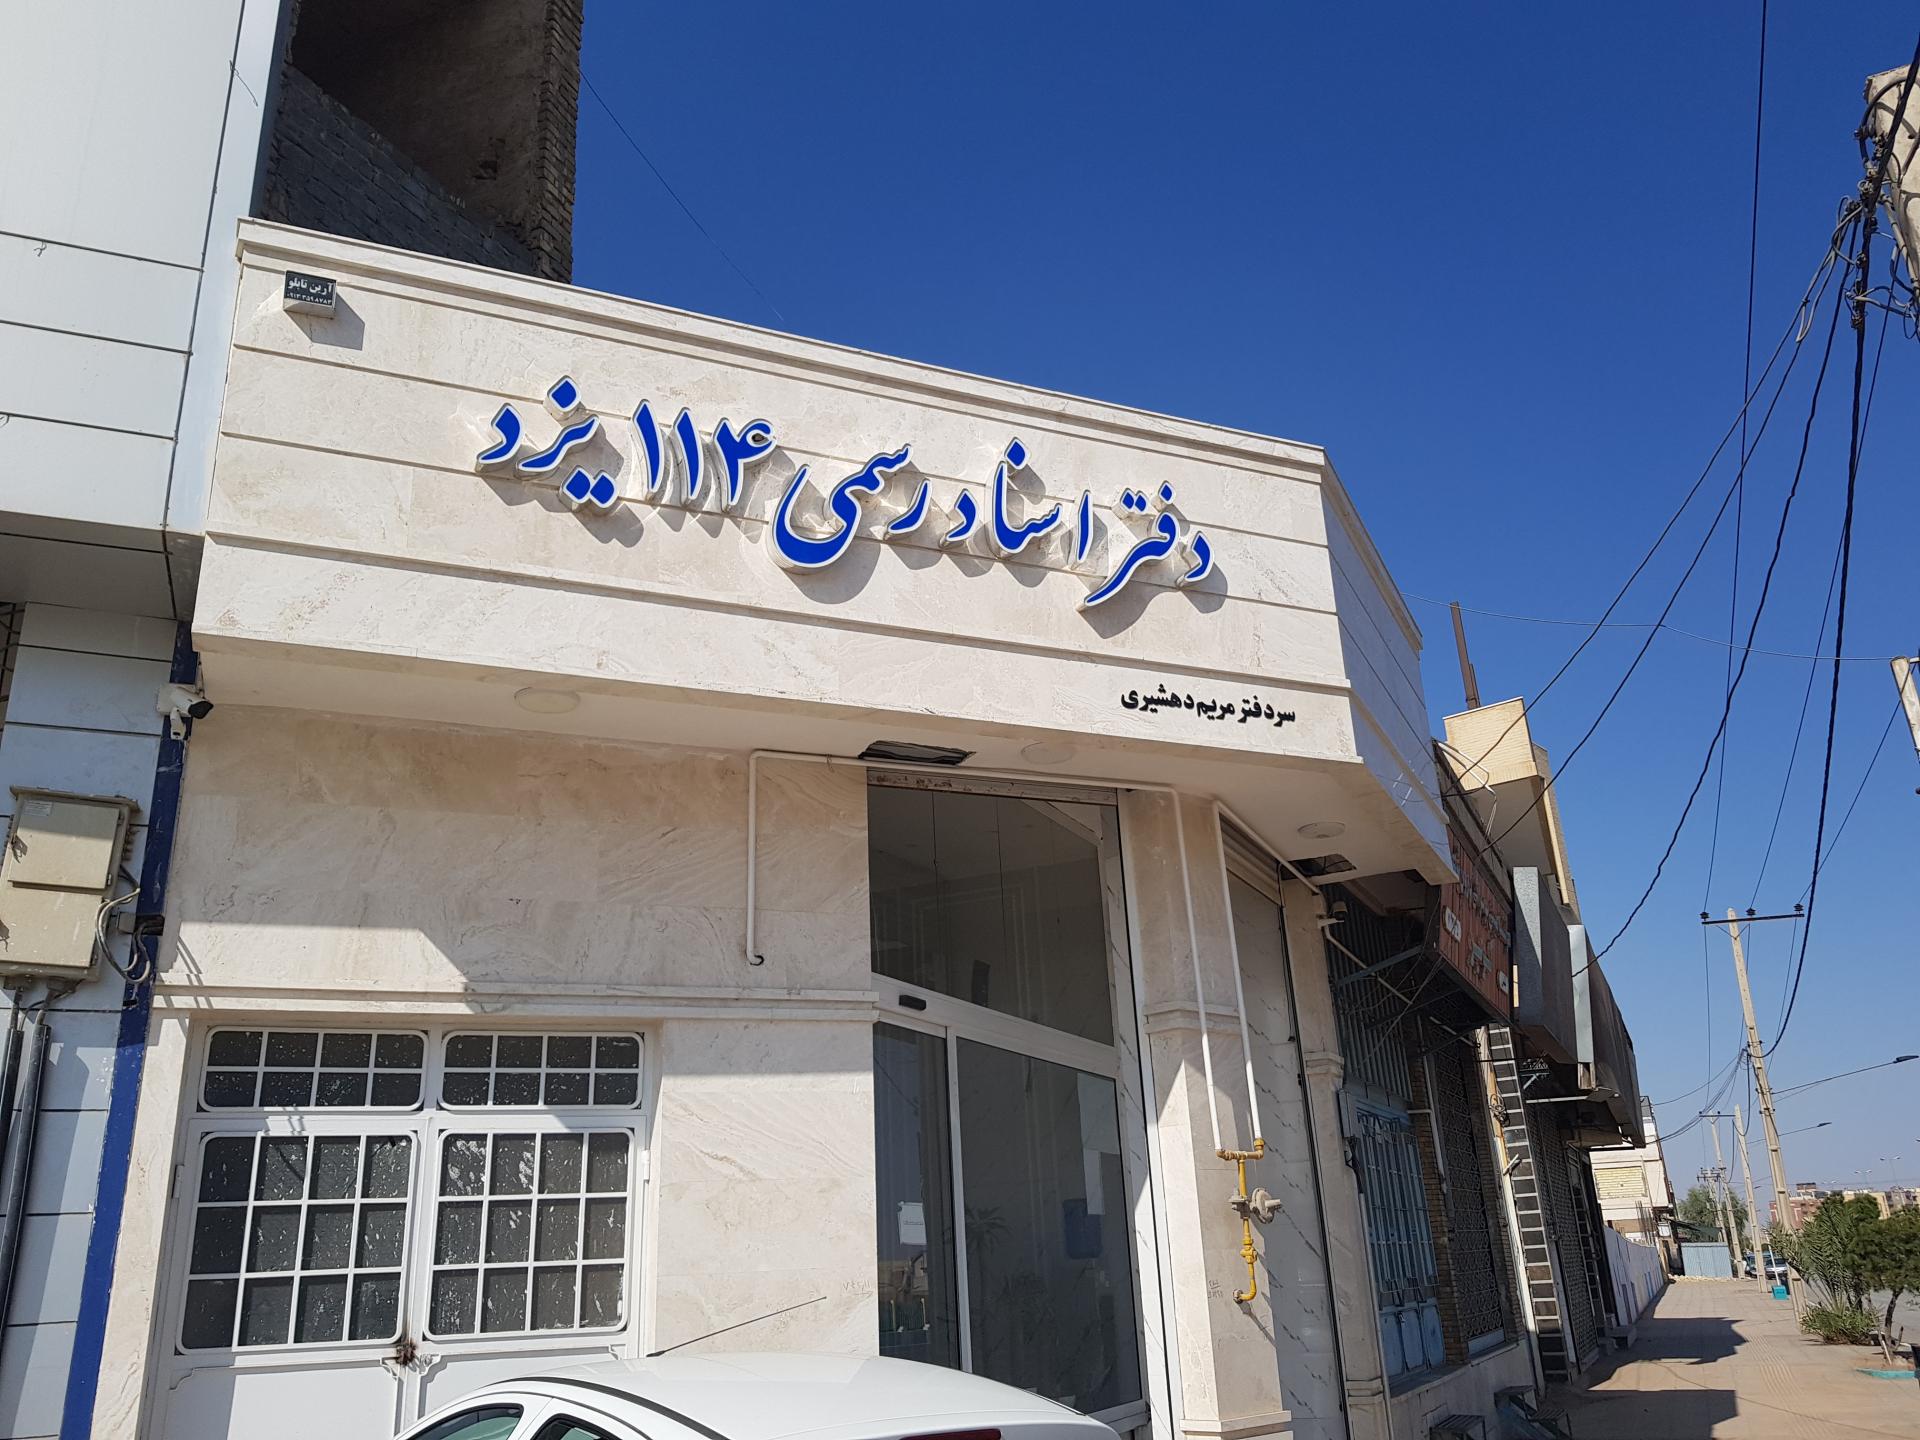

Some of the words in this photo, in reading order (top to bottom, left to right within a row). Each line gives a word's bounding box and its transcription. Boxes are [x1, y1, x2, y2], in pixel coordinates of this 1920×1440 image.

[287, 277, 308, 290] تابلو
[310, 283, 333, 295] آرین
[476, 374, 618, 508] یزد
[632, 398, 777, 510] ۱۱۴
[772, 443, 932, 568] رسمی
[941, 437, 1094, 569] اسناد
[1085, 481, 1214, 606] دفتر
[1120, 683, 1195, 714] دهشیری
[1196, 697, 1236, 721] مریم
